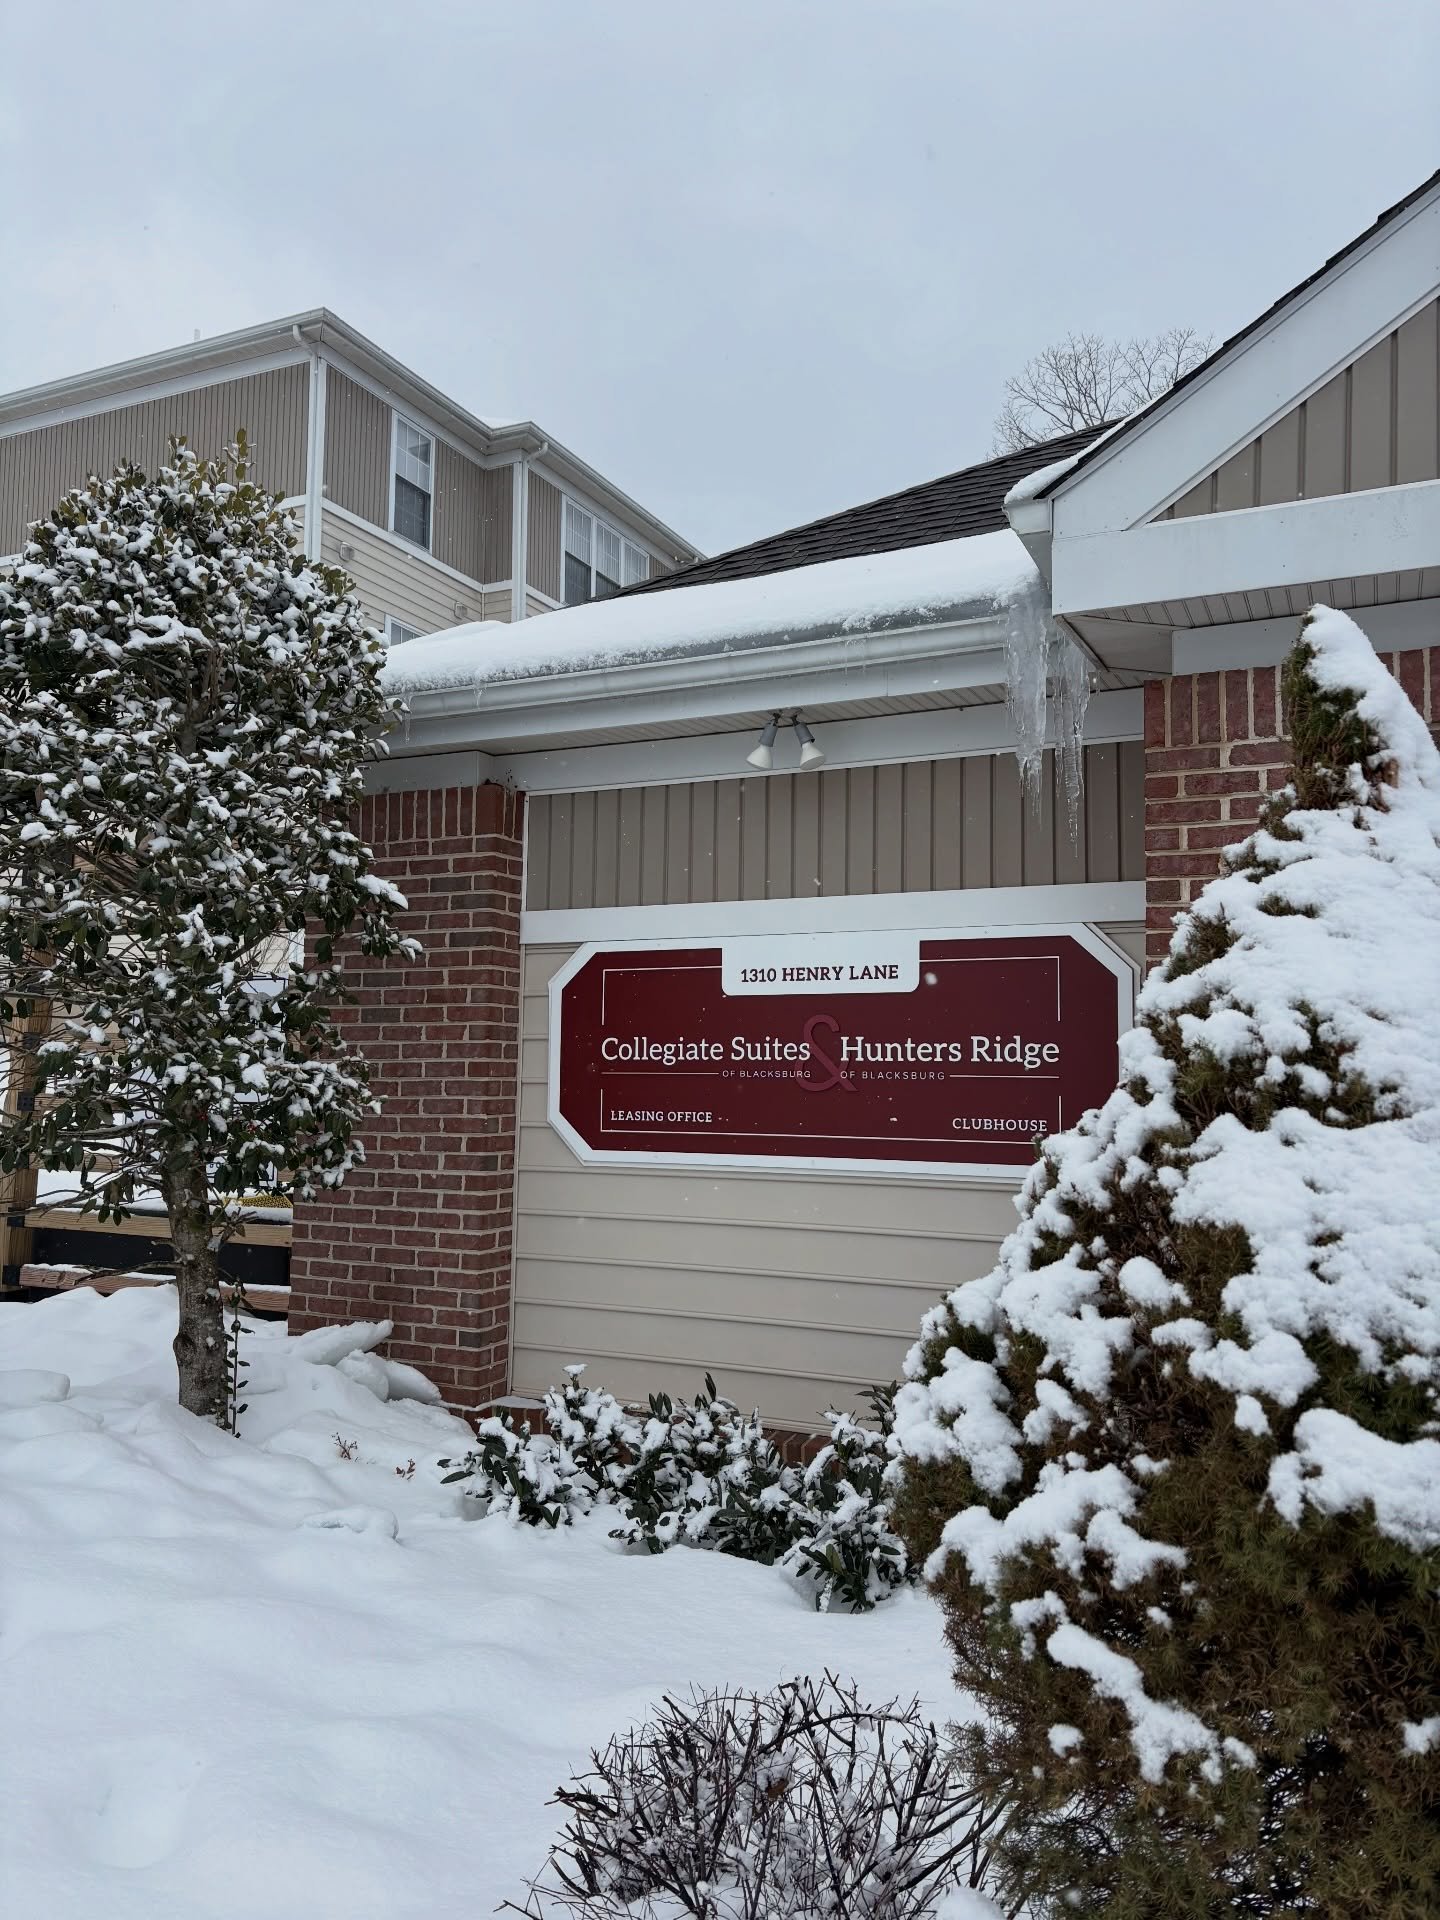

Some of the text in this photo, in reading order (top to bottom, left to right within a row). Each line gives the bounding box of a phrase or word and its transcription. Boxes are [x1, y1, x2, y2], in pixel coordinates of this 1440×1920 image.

[741, 965, 899, 983] 1310 HENRY LANE
[601, 1014, 1060, 1093] Collegiate Suites & Hunters Ridge
[722, 1070, 811, 1079] OF BLACKSBURG
[840, 1071, 945, 1080] OF BLACKSBURG
[610, 1110, 713, 1123] LEASING OFFICE
[952, 1117, 1048, 1132] CLUBHOUSE
